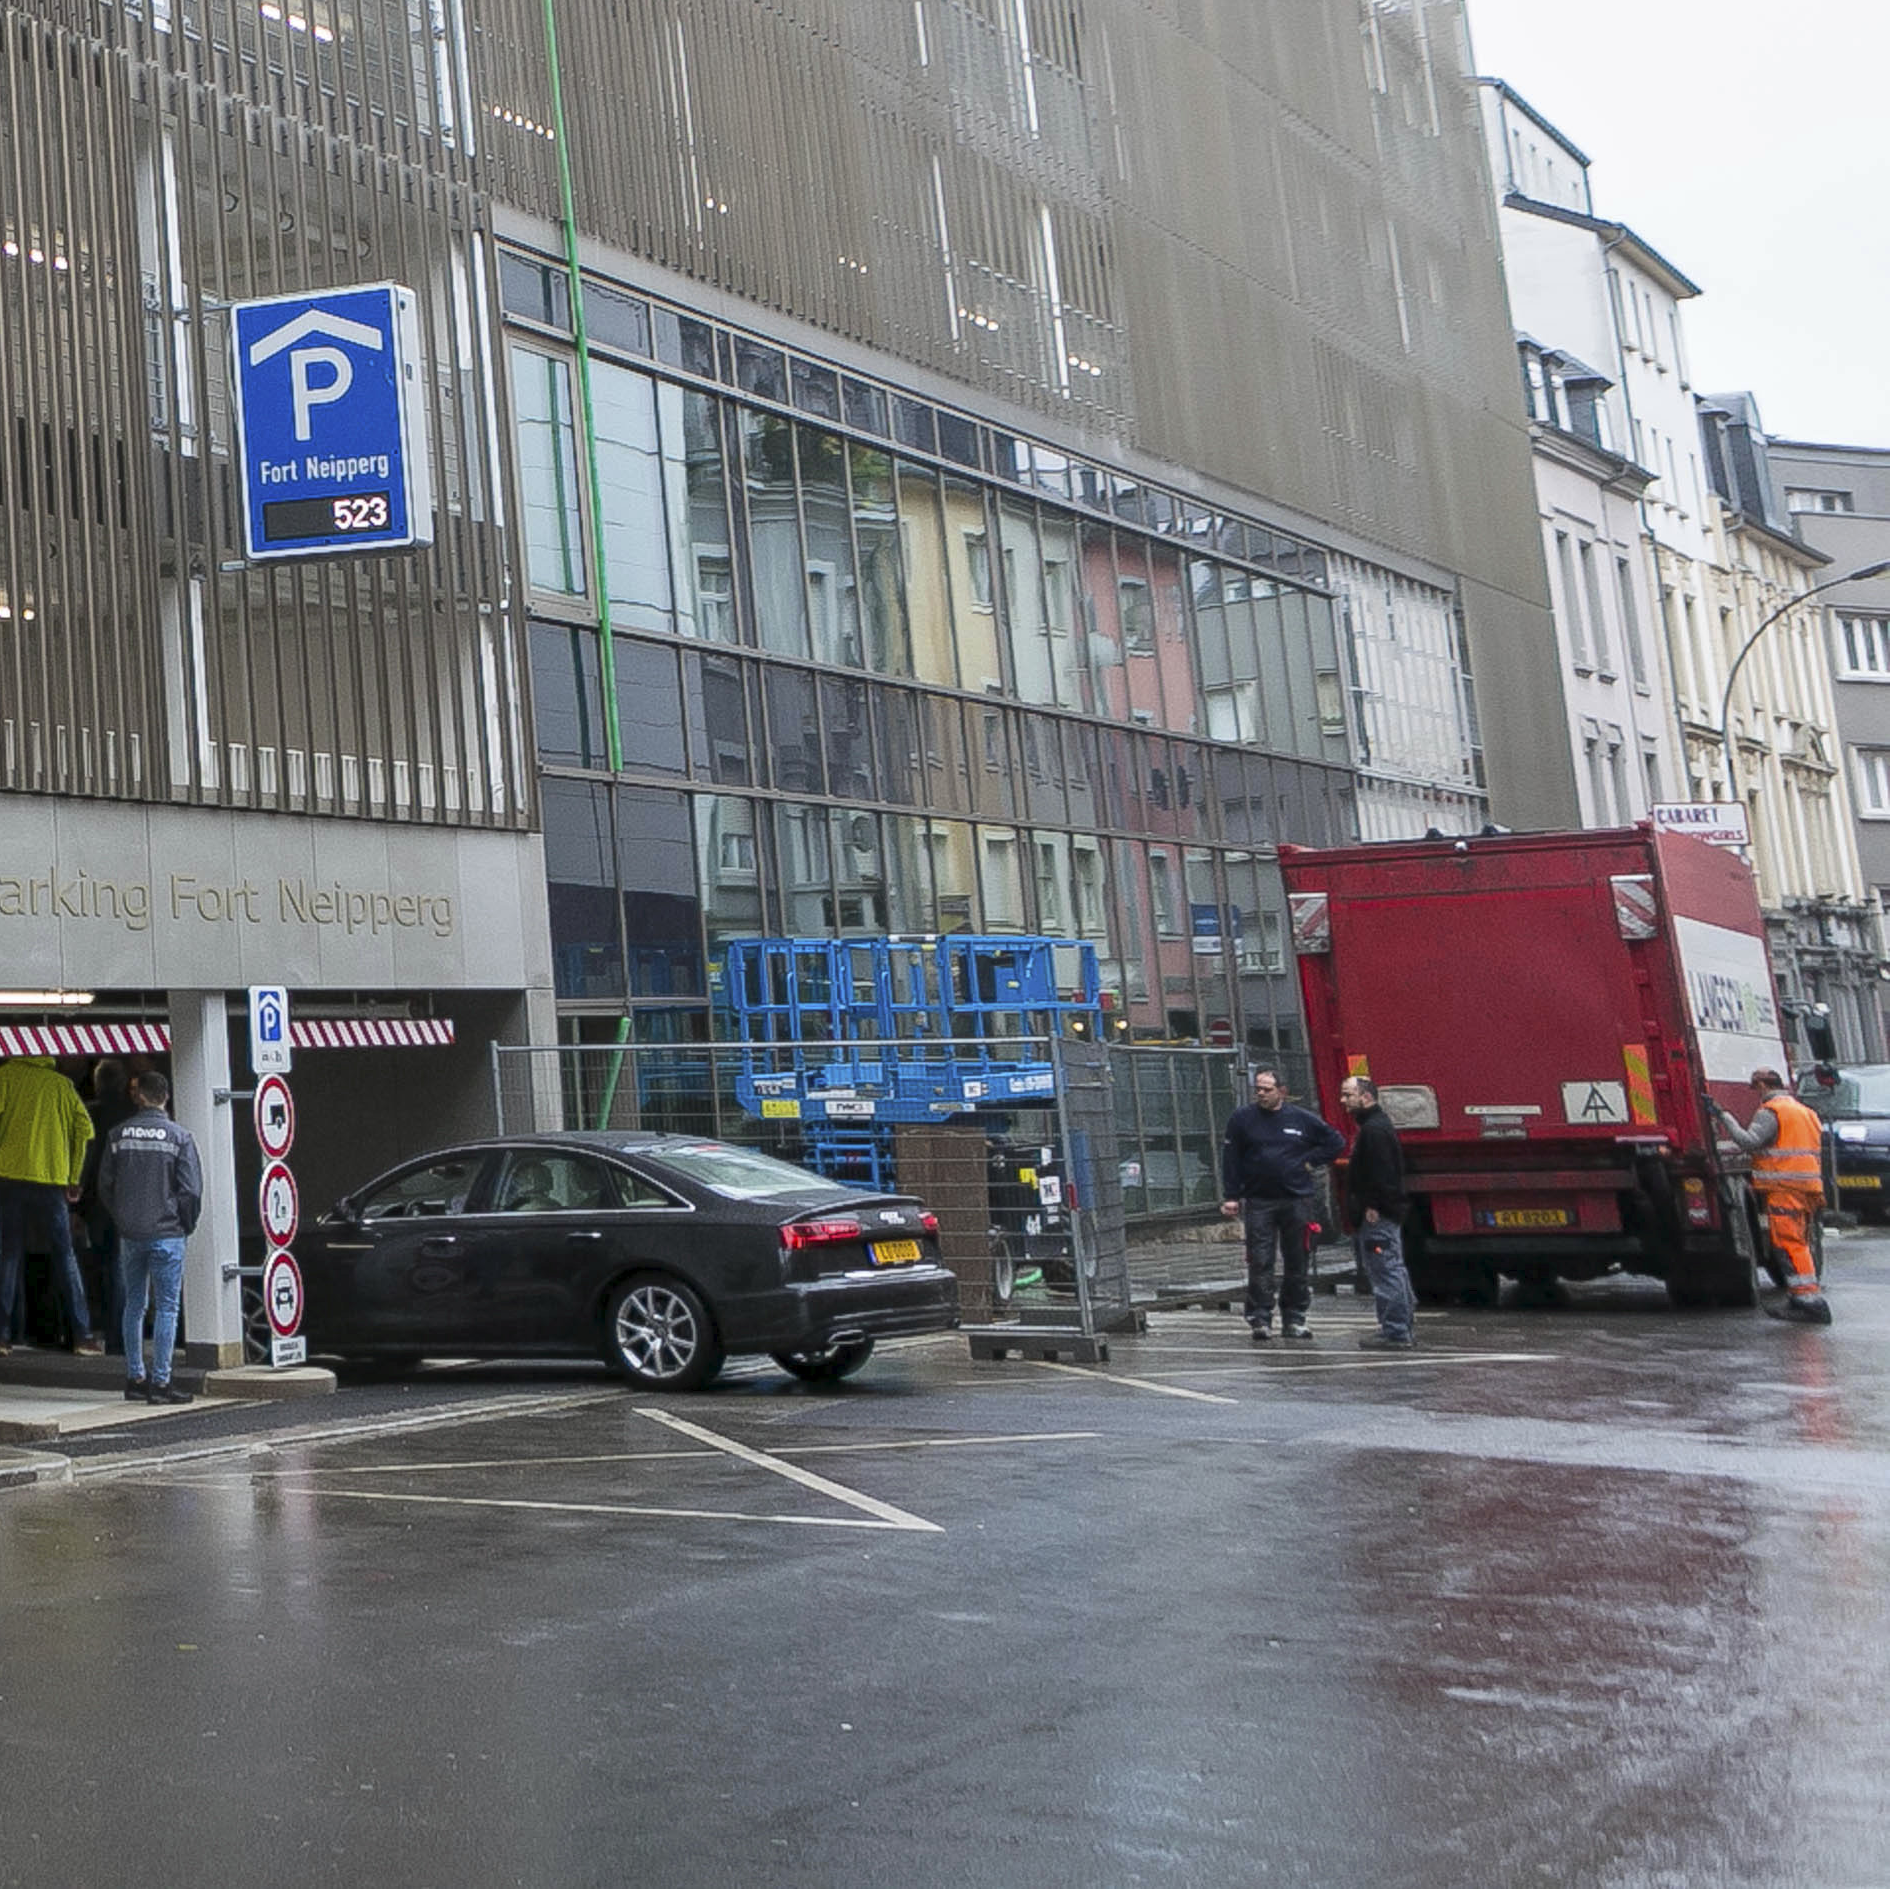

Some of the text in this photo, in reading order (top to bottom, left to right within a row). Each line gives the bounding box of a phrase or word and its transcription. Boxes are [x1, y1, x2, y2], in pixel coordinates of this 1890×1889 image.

[290, 346, 353, 441] P
[261, 454, 389, 484] Fort Neipperg
[332, 496, 388, 530] 523
[1657, 807, 1717, 824] CABARET
[170, 872, 261, 923] Fort
[278, 877, 455, 938] Neipperg
